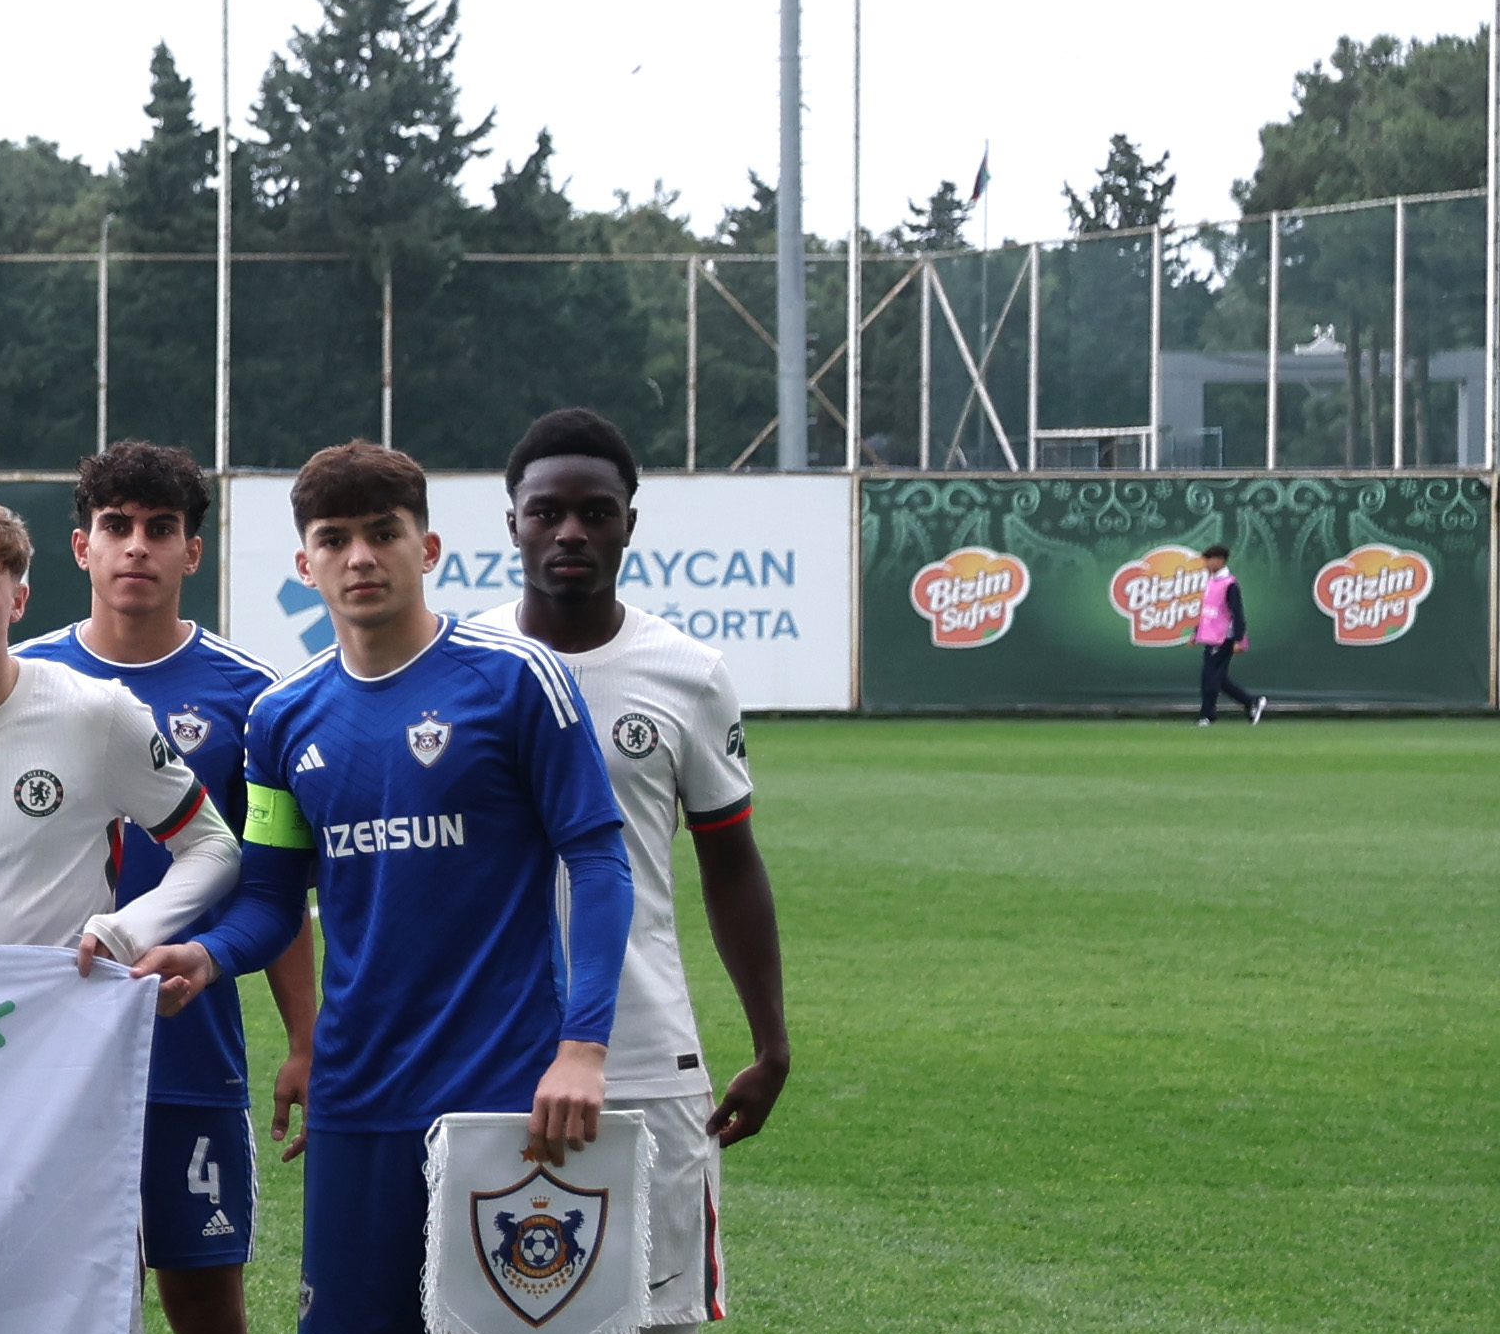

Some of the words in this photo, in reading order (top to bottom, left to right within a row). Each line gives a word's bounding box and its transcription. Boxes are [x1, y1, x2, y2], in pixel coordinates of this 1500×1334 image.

[926, 568, 1011, 612] Bizim
[1125, 566, 1209, 610] Bizim
[1329, 567, 1415, 609] Bizim
[941, 601, 1002, 633] Sufre
[1344, 597, 1405, 630] Sufre
[187, 1136, 221, 1203] 4
[201, 1223, 235, 1237] adidas
